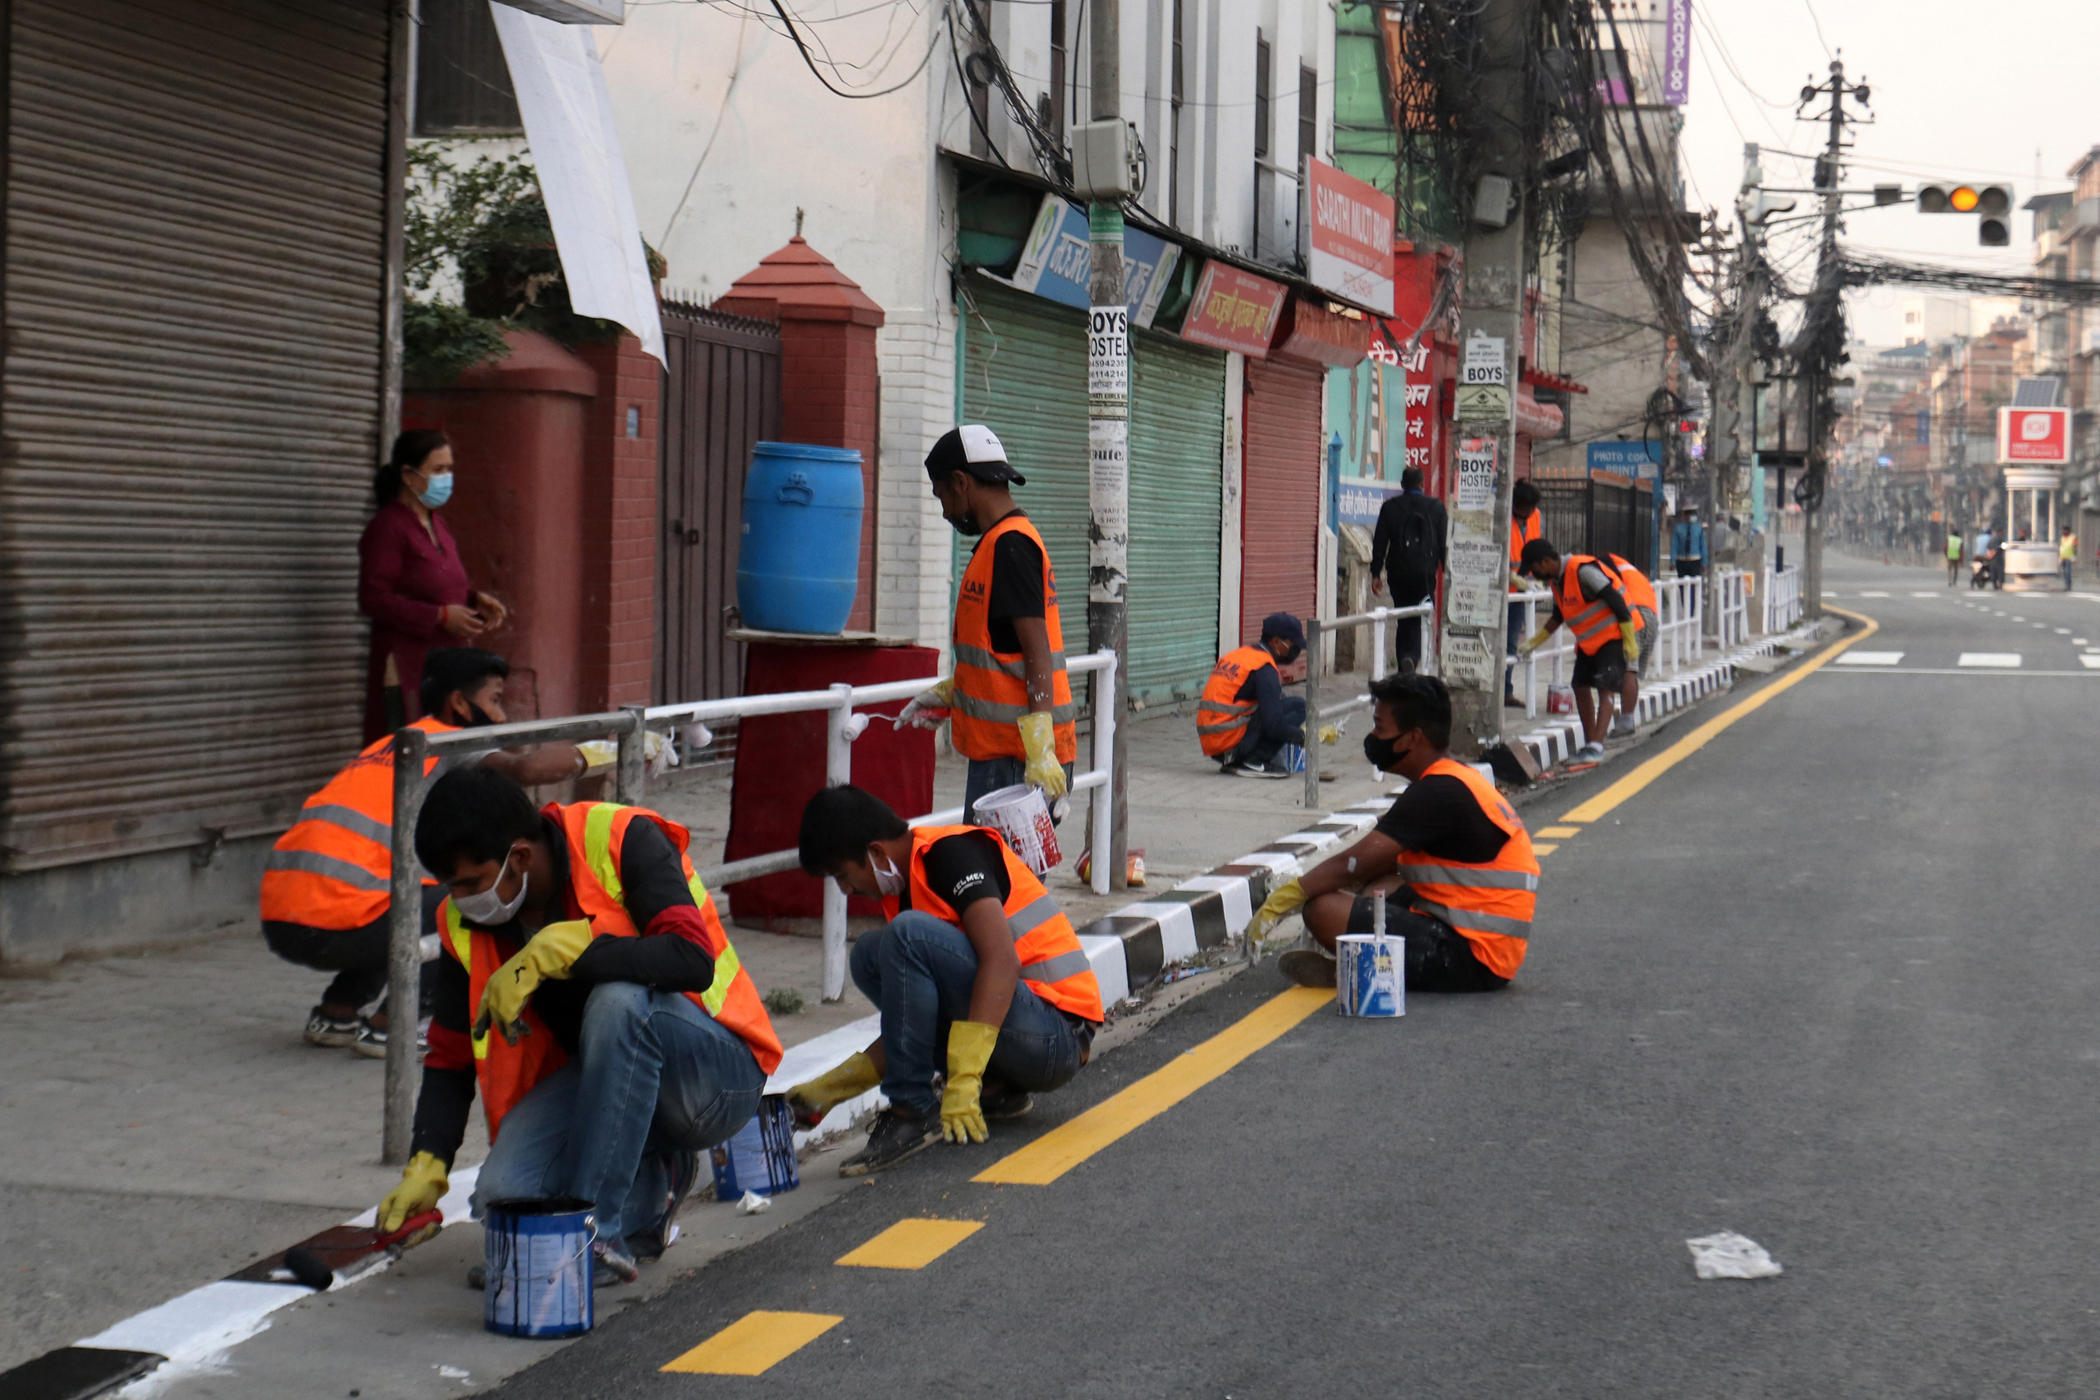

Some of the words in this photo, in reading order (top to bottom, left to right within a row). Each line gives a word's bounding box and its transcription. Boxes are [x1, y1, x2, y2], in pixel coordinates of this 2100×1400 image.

[1091, 337, 1127, 357] OSTEL
[1468, 367, 1502, 381] BOYS
[1405, 447, 1429, 467] ३१८
[1593, 450, 1623, 462] PHOTO
[1461, 459, 1493, 473] BOYS
[1461, 474, 1490, 487] HOSTE
